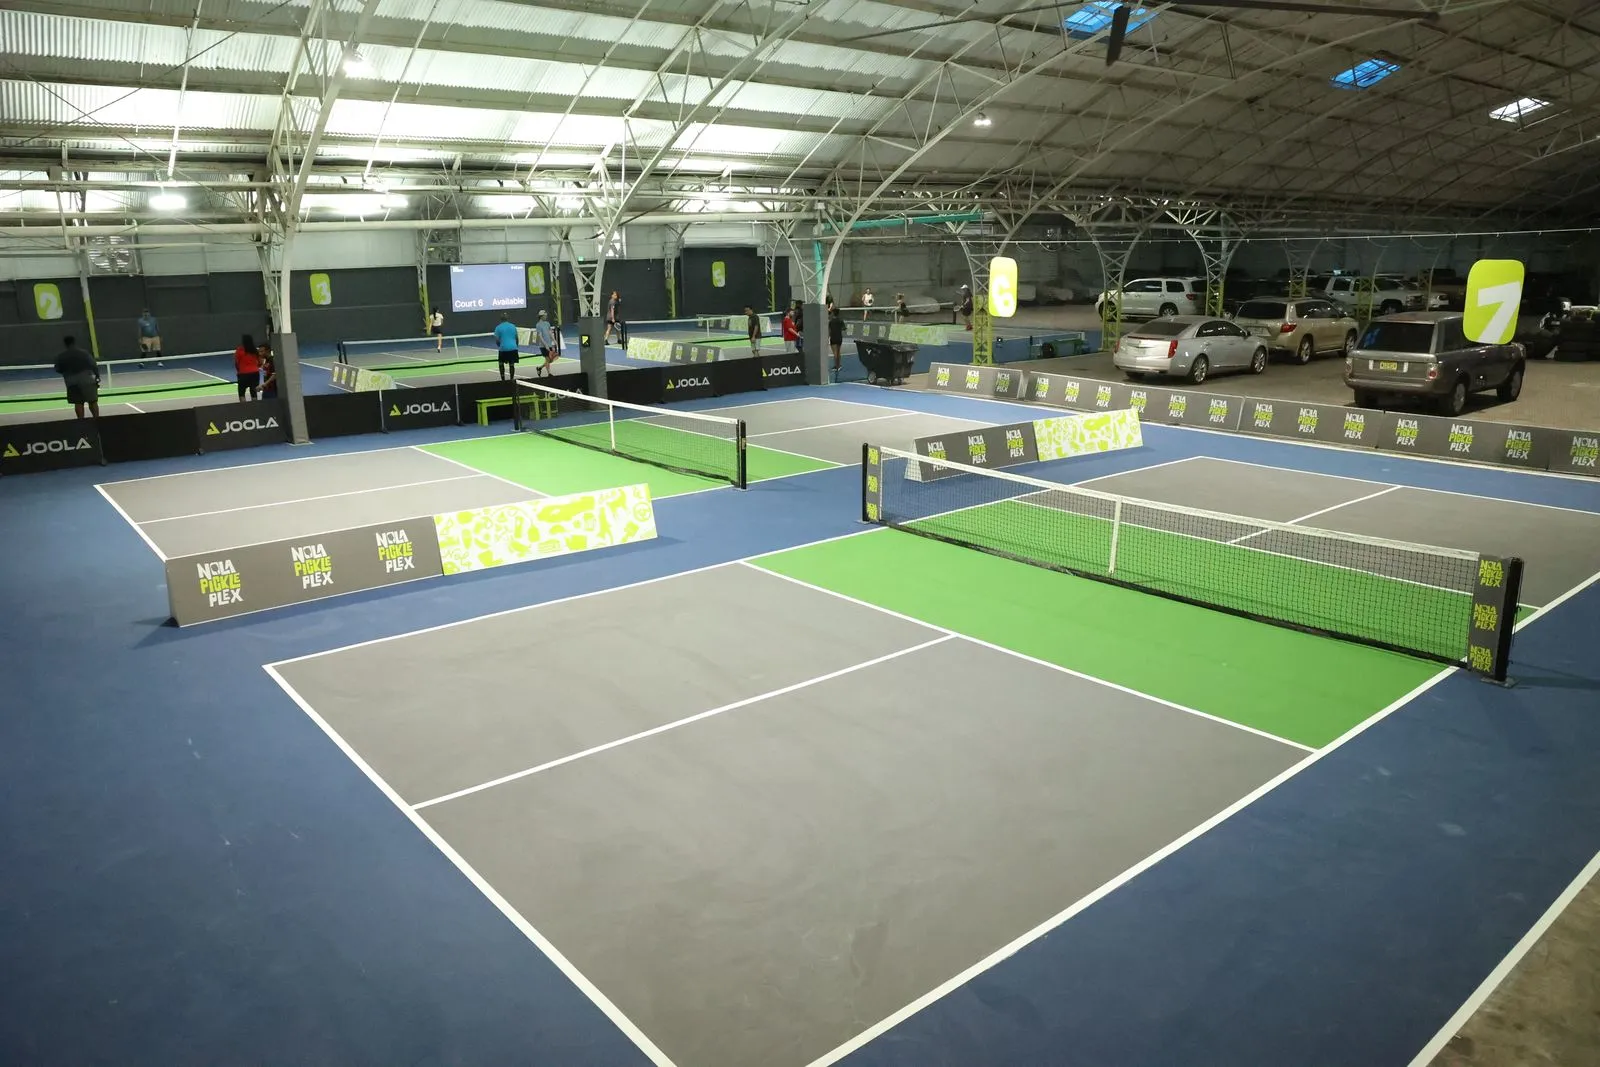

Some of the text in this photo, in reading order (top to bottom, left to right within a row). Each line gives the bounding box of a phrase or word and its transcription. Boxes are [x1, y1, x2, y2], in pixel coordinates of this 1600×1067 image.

[316, 282, 331, 305] 3
[455, 297, 524, 308] Court 6 Available
[992, 275, 1016, 317] 6
[40, 292, 63, 319] 2
[1478, 281, 1520, 344] 7
[768, 366, 801, 377] JOOLA
[676, 377, 710, 388] JOOLA
[403, 402, 452, 415] JOOLA
[222, 417, 279, 433] JOOLA
[22, 438, 92, 455] JOOLA
[1450, 443, 1470, 453] PLEX
[1507, 449, 1528, 459] PLEX
[1572, 456, 1596, 467] PLEX
[375, 529, 408, 548] NOLA
[291, 543, 327, 563] NOLA
[378, 541, 413, 561] PICKLE
[197, 559, 237, 580] NOLA
[294, 556, 332, 577] PICKLE
[386, 555, 415, 573] PLEX
[200, 573, 241, 594] PICKLE
[302, 572, 334, 589] PLEX
[1480, 578, 1501, 587] PLEX
[208, 588, 244, 607] PLEX
